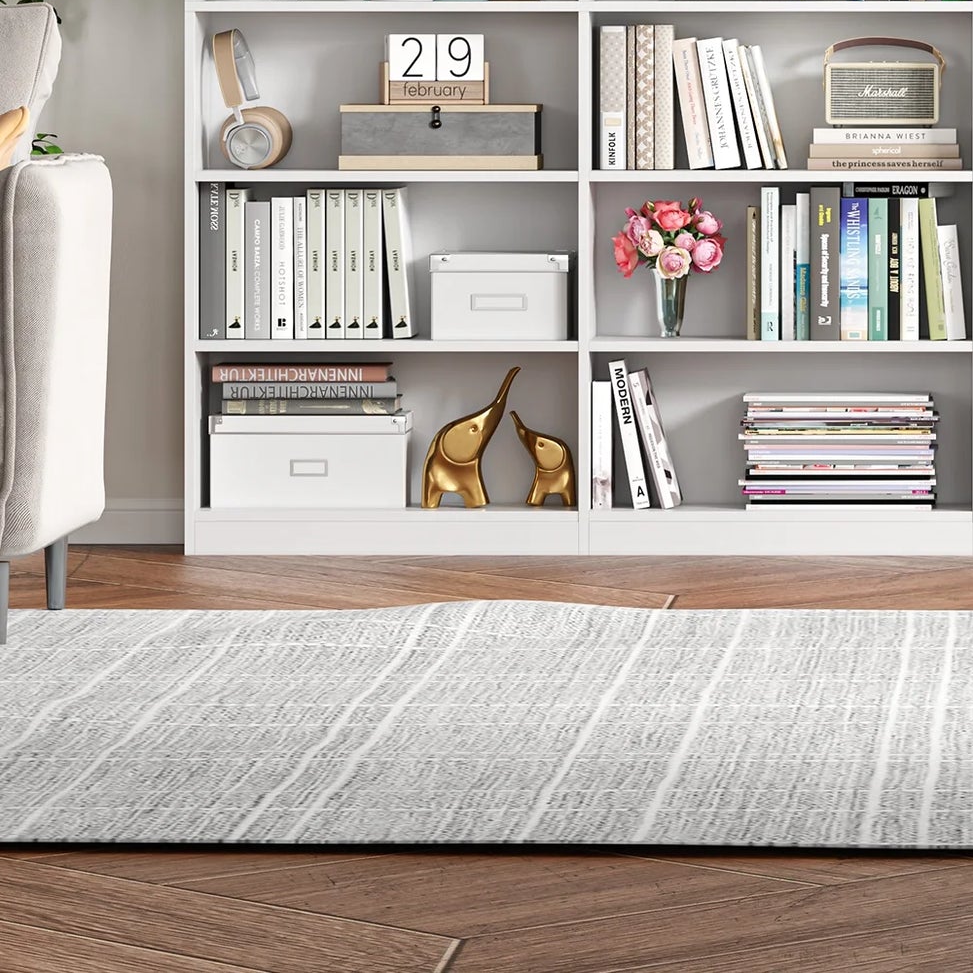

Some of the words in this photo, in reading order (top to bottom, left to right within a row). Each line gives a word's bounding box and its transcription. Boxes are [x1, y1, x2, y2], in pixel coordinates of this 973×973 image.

[401, 37, 423, 77] 2
[448, 37, 471, 77] 9
[404, 82, 466, 100] february
[858, 84, 908, 98] Marshall
[872, 147, 901, 155] spherical
[892, 186, 918, 195] ERAGON
[847, 210, 860, 266] WHISTLING
[890, 257, 898, 268] BOY
[298, 270, 303, 279] OF
[847, 268, 860, 299] SANDS
[890, 276, 898, 292] ABOUT
[220, 368, 362, 381] INNENARCHITEKTUR
[231, 386, 374, 398] INNENARCHITEKTUR
[615, 367, 632, 425] MODERN
[637, 486, 645, 497] A
